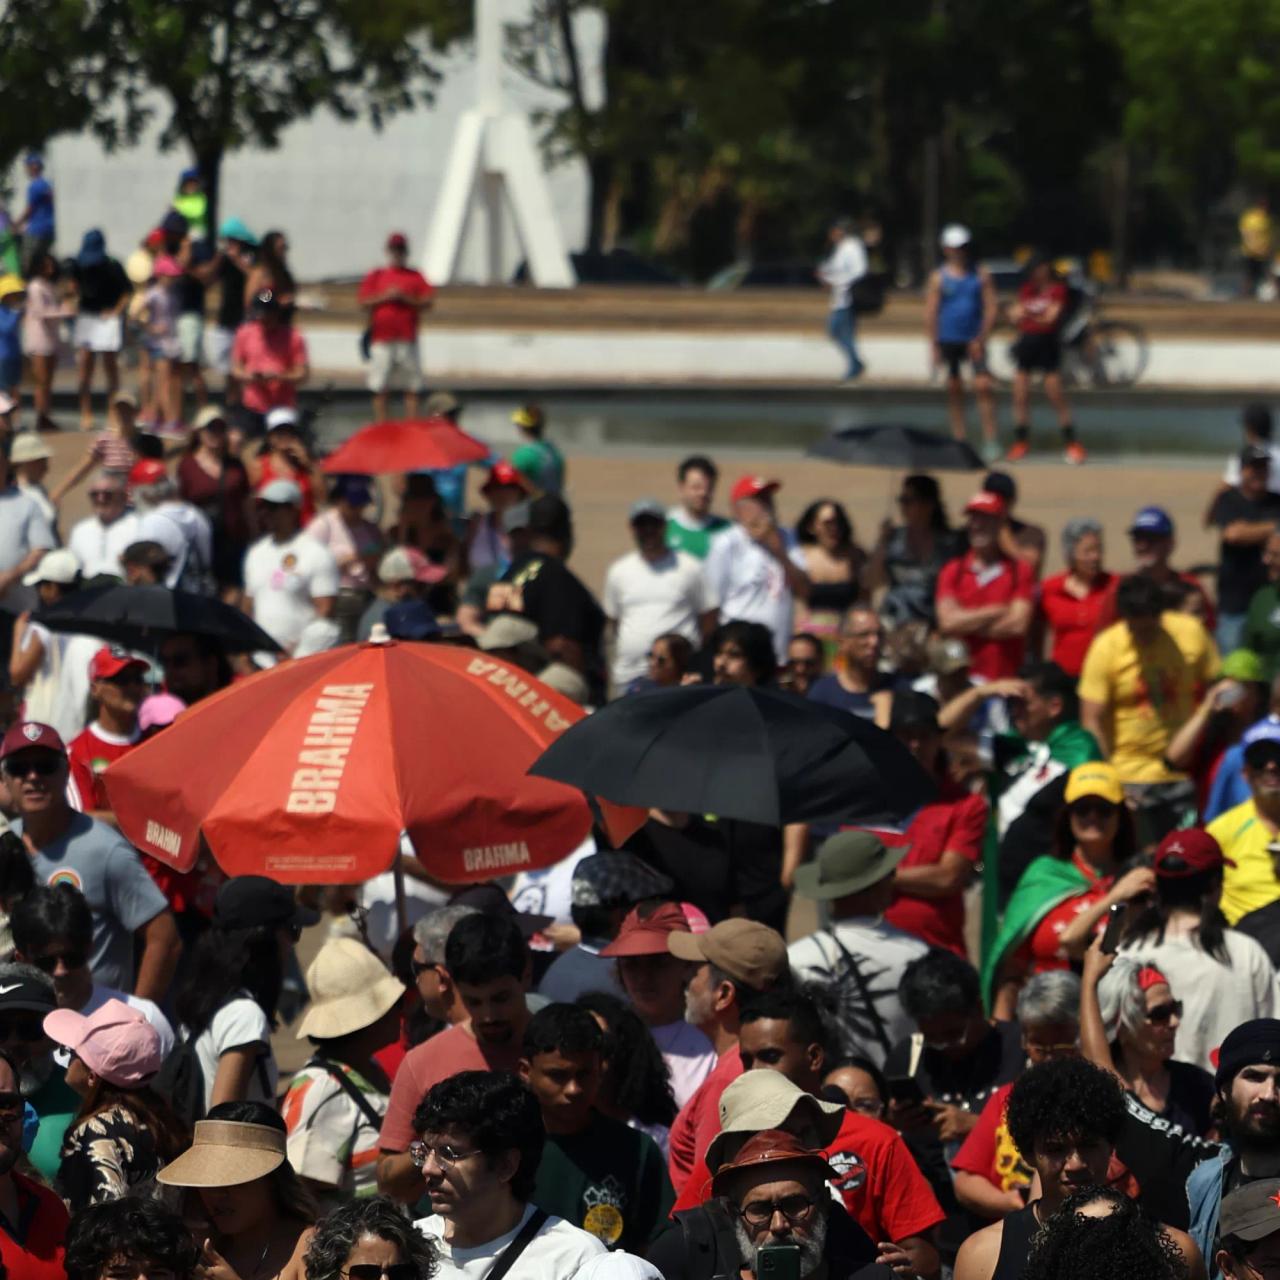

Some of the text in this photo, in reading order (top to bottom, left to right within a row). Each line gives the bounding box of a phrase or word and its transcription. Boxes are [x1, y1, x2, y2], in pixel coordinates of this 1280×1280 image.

[286, 682, 375, 814] BRAHMA
[145, 819, 182, 858] BRAHMA
[463, 841, 531, 872] BRAHMA
